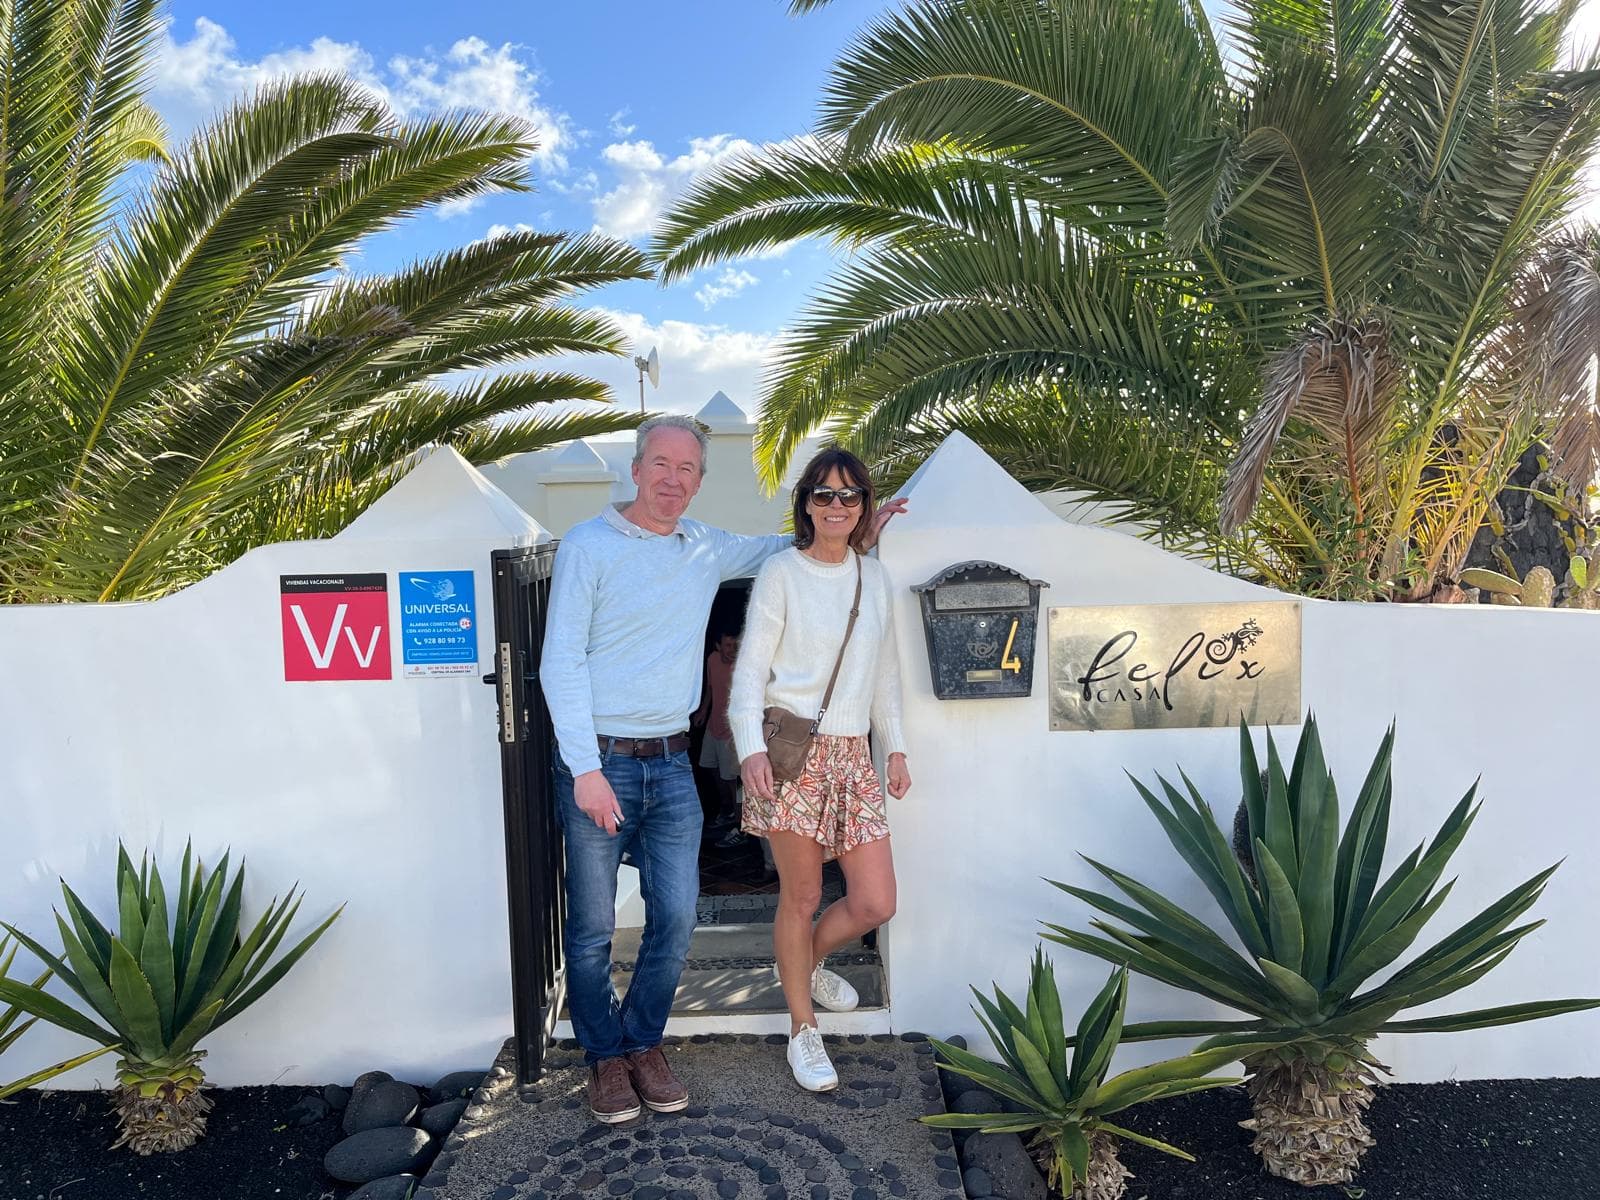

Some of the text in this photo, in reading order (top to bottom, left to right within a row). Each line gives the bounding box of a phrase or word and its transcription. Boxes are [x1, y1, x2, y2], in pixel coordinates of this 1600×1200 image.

[404, 603, 472, 614] UNIVERSAL
[423, 637, 437, 645] 928
[457, 636, 466, 644] 73
[1001, 618, 1021, 674] 4
[1096, 687, 1161, 703] CASA
